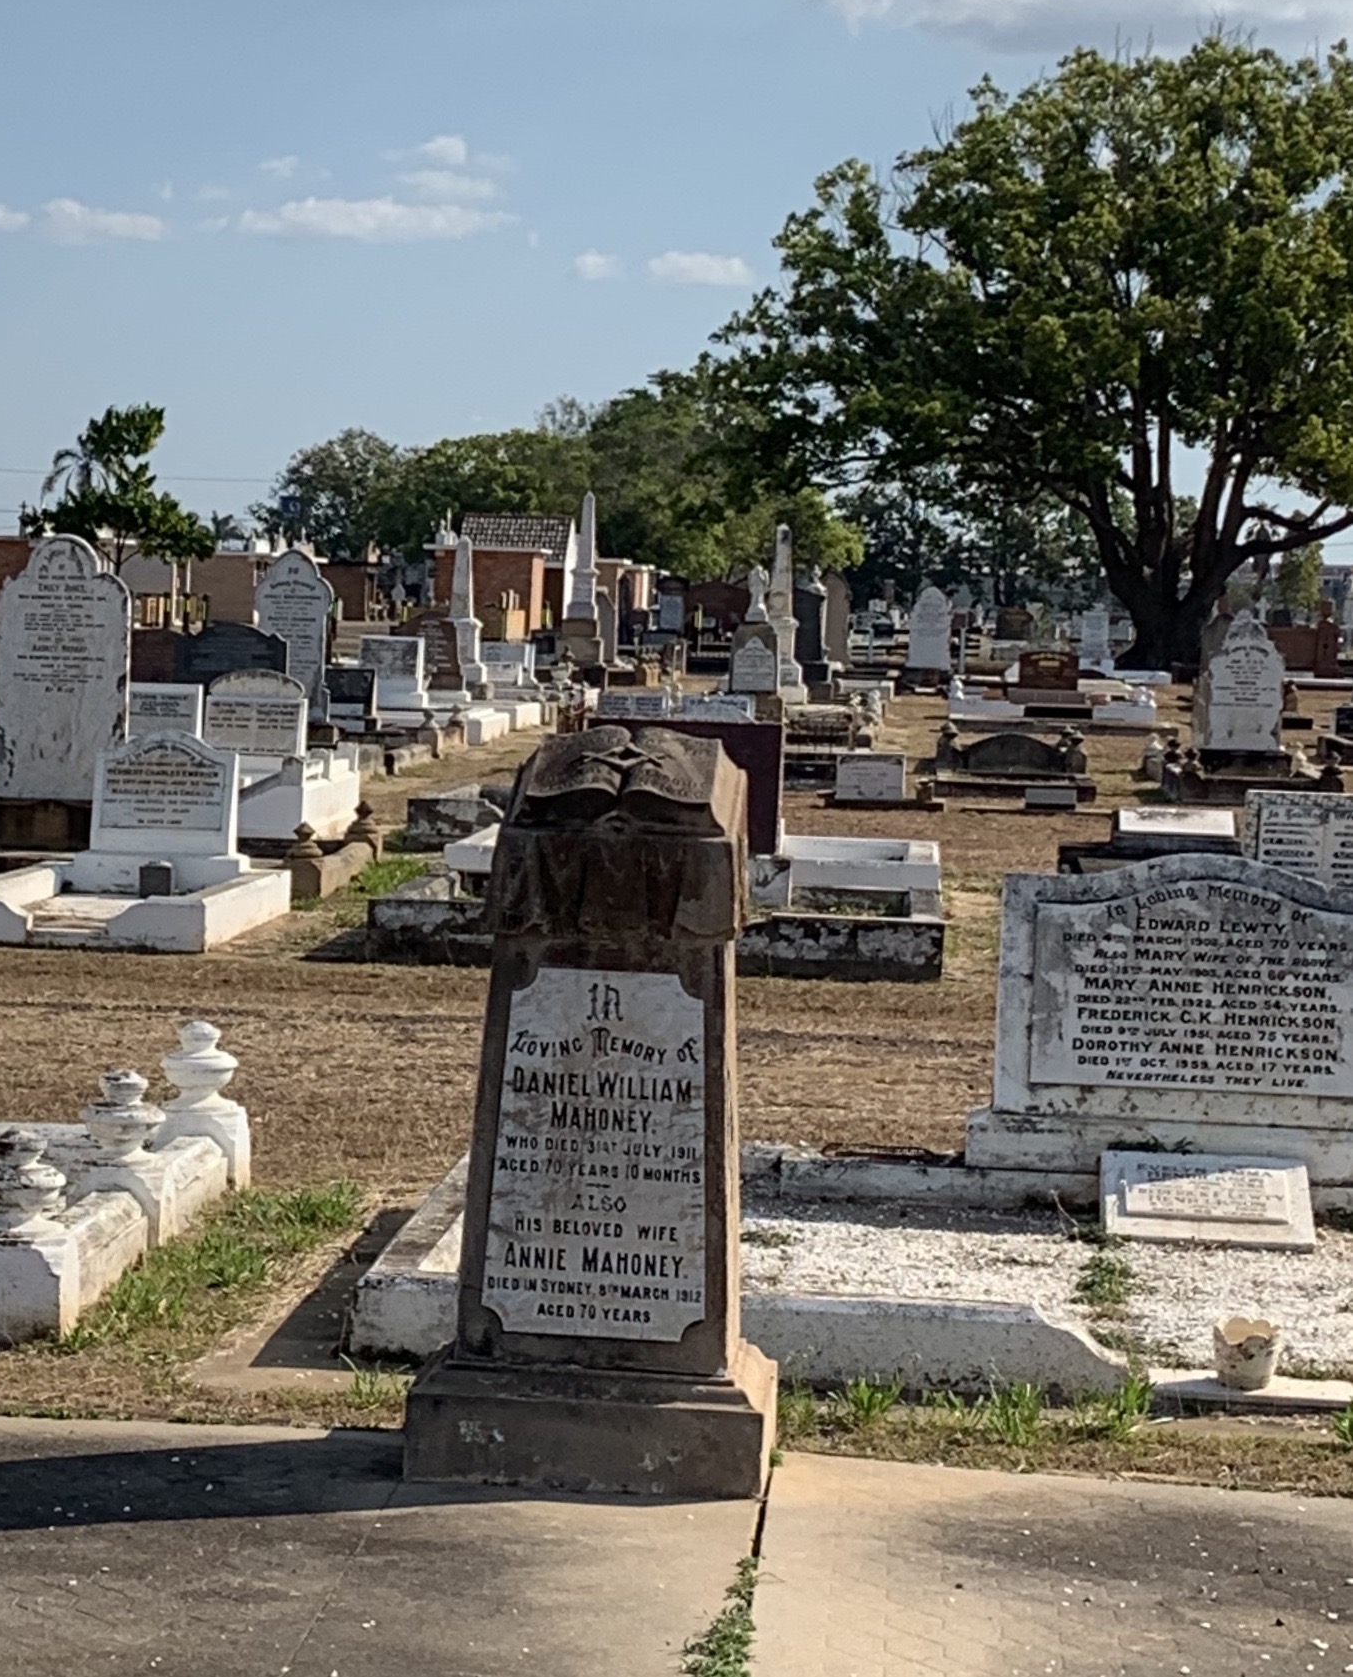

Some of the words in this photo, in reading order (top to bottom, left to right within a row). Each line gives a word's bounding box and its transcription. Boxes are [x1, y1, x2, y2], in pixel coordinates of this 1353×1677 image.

[1104, 903, 1128, 919] In
[1133, 886, 1198, 910] Loving
[1207, 884, 1282, 916] Memory
[1136, 917, 1210, 932] EDWARD
[1063, 932, 1097, 942] DIED
[1132, 935, 1182, 945] MARCH
[1225, 938, 1264, 949] AGED
[1269, 939, 1290, 950] 70
[1093, 948, 1129, 960] ALSO
[1134, 948, 1188, 961] MARY
[1193, 952, 1229, 963] WIFE
[1235, 954, 1254, 965] OF
[1259, 955, 1285, 966] THE
[1291, 958, 1335, 968] ABOVE
[1074, 964, 1108, 974] DIED
[1150, 966, 1182, 976] MAY
[1224, 969, 1262, 979] AGED
[1084, 976, 1137, 992] MARY
[1148, 978, 1204, 993] ANNIE
[1075, 994, 1111, 1004] DIED
[1220, 999, 1258, 1010] AGED
[1288, 1003, 1343, 1014] YEARS.
[1077, 1006, 1172, 1023] FREDERICK
[1080, 1025, 1113, 1035] DIED
[1143, 1028, 1178, 1038] JULY
[1216, 1030, 1251, 1041] AGED
[1257, 1030, 1277, 1042] 75
[1281, 1032, 1334, 1044] YEARS.
[510, 1029, 584, 1058] LOVING
[590, 1026, 668, 1065] MEMORY
[1072, 1037, 1153, 1053] DOROTHY
[1158, 1040, 1205, 1055] ANNE
[1077, 1055, 1109, 1066] DIED
[1215, 1061, 1255, 1072] AGED
[1261, 1062, 1277, 1073] 17
[512, 1066, 591, 1098] DANIEL
[596, 1070, 693, 1103] WILLIAM
[1106, 1069, 1215, 1084] NEVERTHELESS
[1225, 1075, 1262, 1086] THEY
[550, 1101, 658, 1135] MAHONEY.
[505, 1135, 539, 1150] WHO
[544, 1137, 579, 1153] DIED
[622, 1142, 664, 1159] JULY
[671, 1146, 697, 1160] 1911
[498, 1159, 540, 1173] AGED
[545, 1159, 562, 1174] 70
[568, 1164, 619, 1179] YEARS
[625, 1164, 640, 1180] 10
[643, 1168, 701, 1185] MONTHS
[570, 1193, 627, 1213] ALSO
[514, 1216, 542, 1233] HIS
[553, 1219, 623, 1238] BELOVED
[637, 1224, 678, 1242] WIFE
[504, 1241, 567, 1271] ANNIE
[582, 1246, 689, 1279] MAHONEY.
[487, 1276, 520, 1291] DIED
[524, 1279, 537, 1292] IN
[620, 1285, 669, 1301] MARCH
[676, 1289, 702, 1304] 1912
[537, 1303, 575, 1319] AGED
[580, 1304, 597, 1320] 70
[602, 1307, 651, 1323] YEARS
